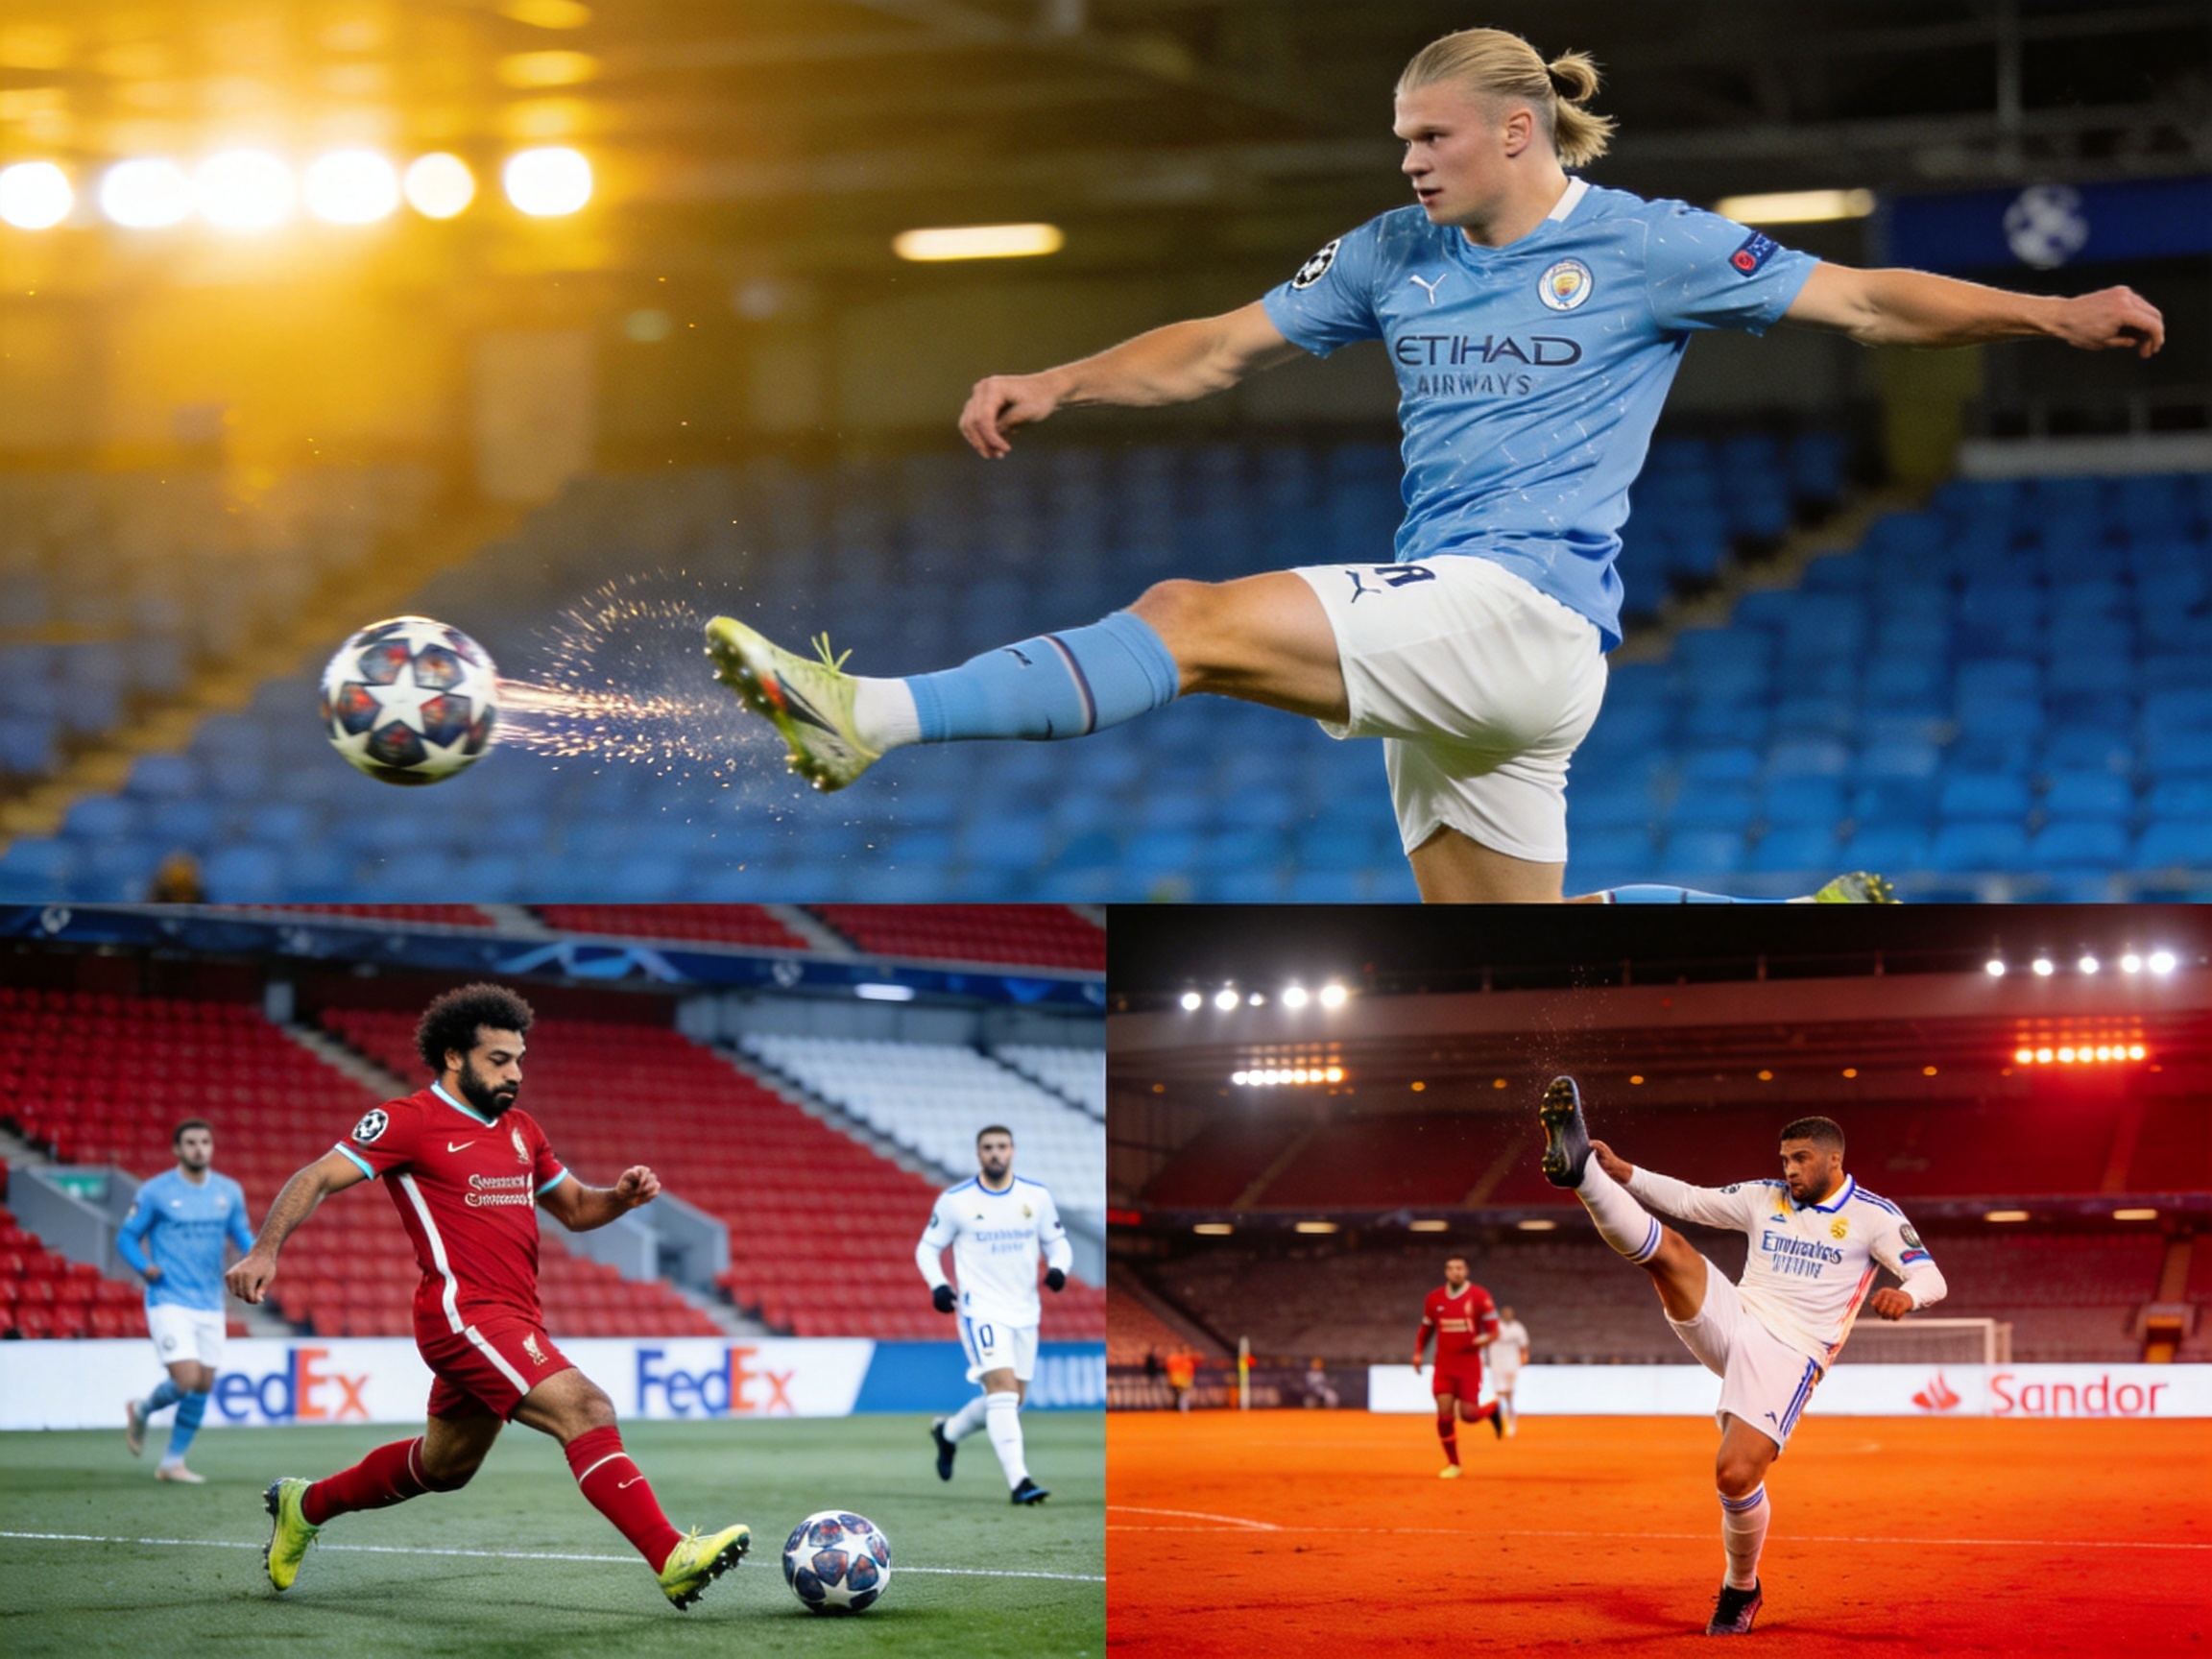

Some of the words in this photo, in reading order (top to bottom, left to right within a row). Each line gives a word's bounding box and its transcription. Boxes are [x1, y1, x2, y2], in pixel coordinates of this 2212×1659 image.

[1395, 335, 1583, 367] ETIHAD
[1416, 373, 1533, 398] AIRWAYS
[212, 1347, 370, 1420] edEx
[637, 1346, 795, 1417] FedEx
[1989, 1373, 2169, 1415] Sandor
